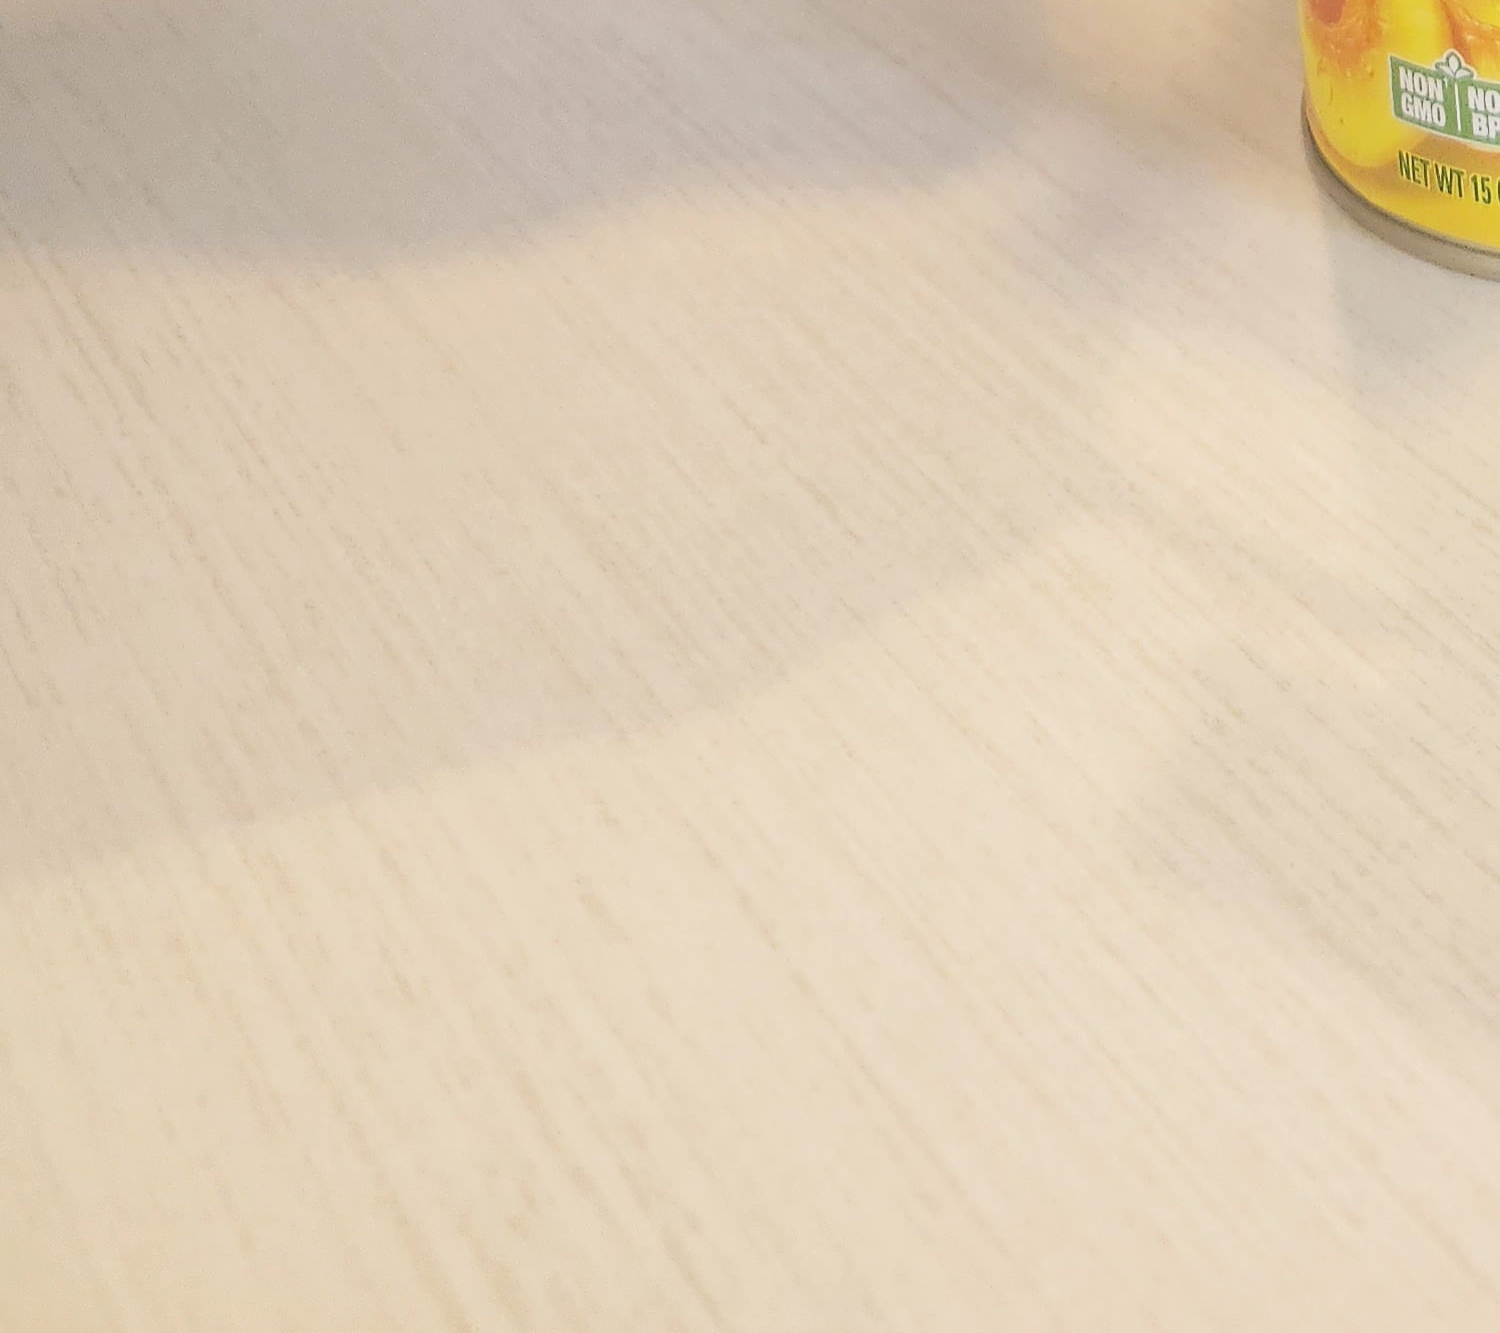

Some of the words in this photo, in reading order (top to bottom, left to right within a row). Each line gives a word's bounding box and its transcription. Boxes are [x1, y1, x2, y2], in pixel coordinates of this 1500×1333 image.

[1401, 93, 1446, 127] GMO
[1398, 150, 1430, 187] NET
[1434, 162, 1465, 198] WT
[1470, 174, 1491, 205] 15
